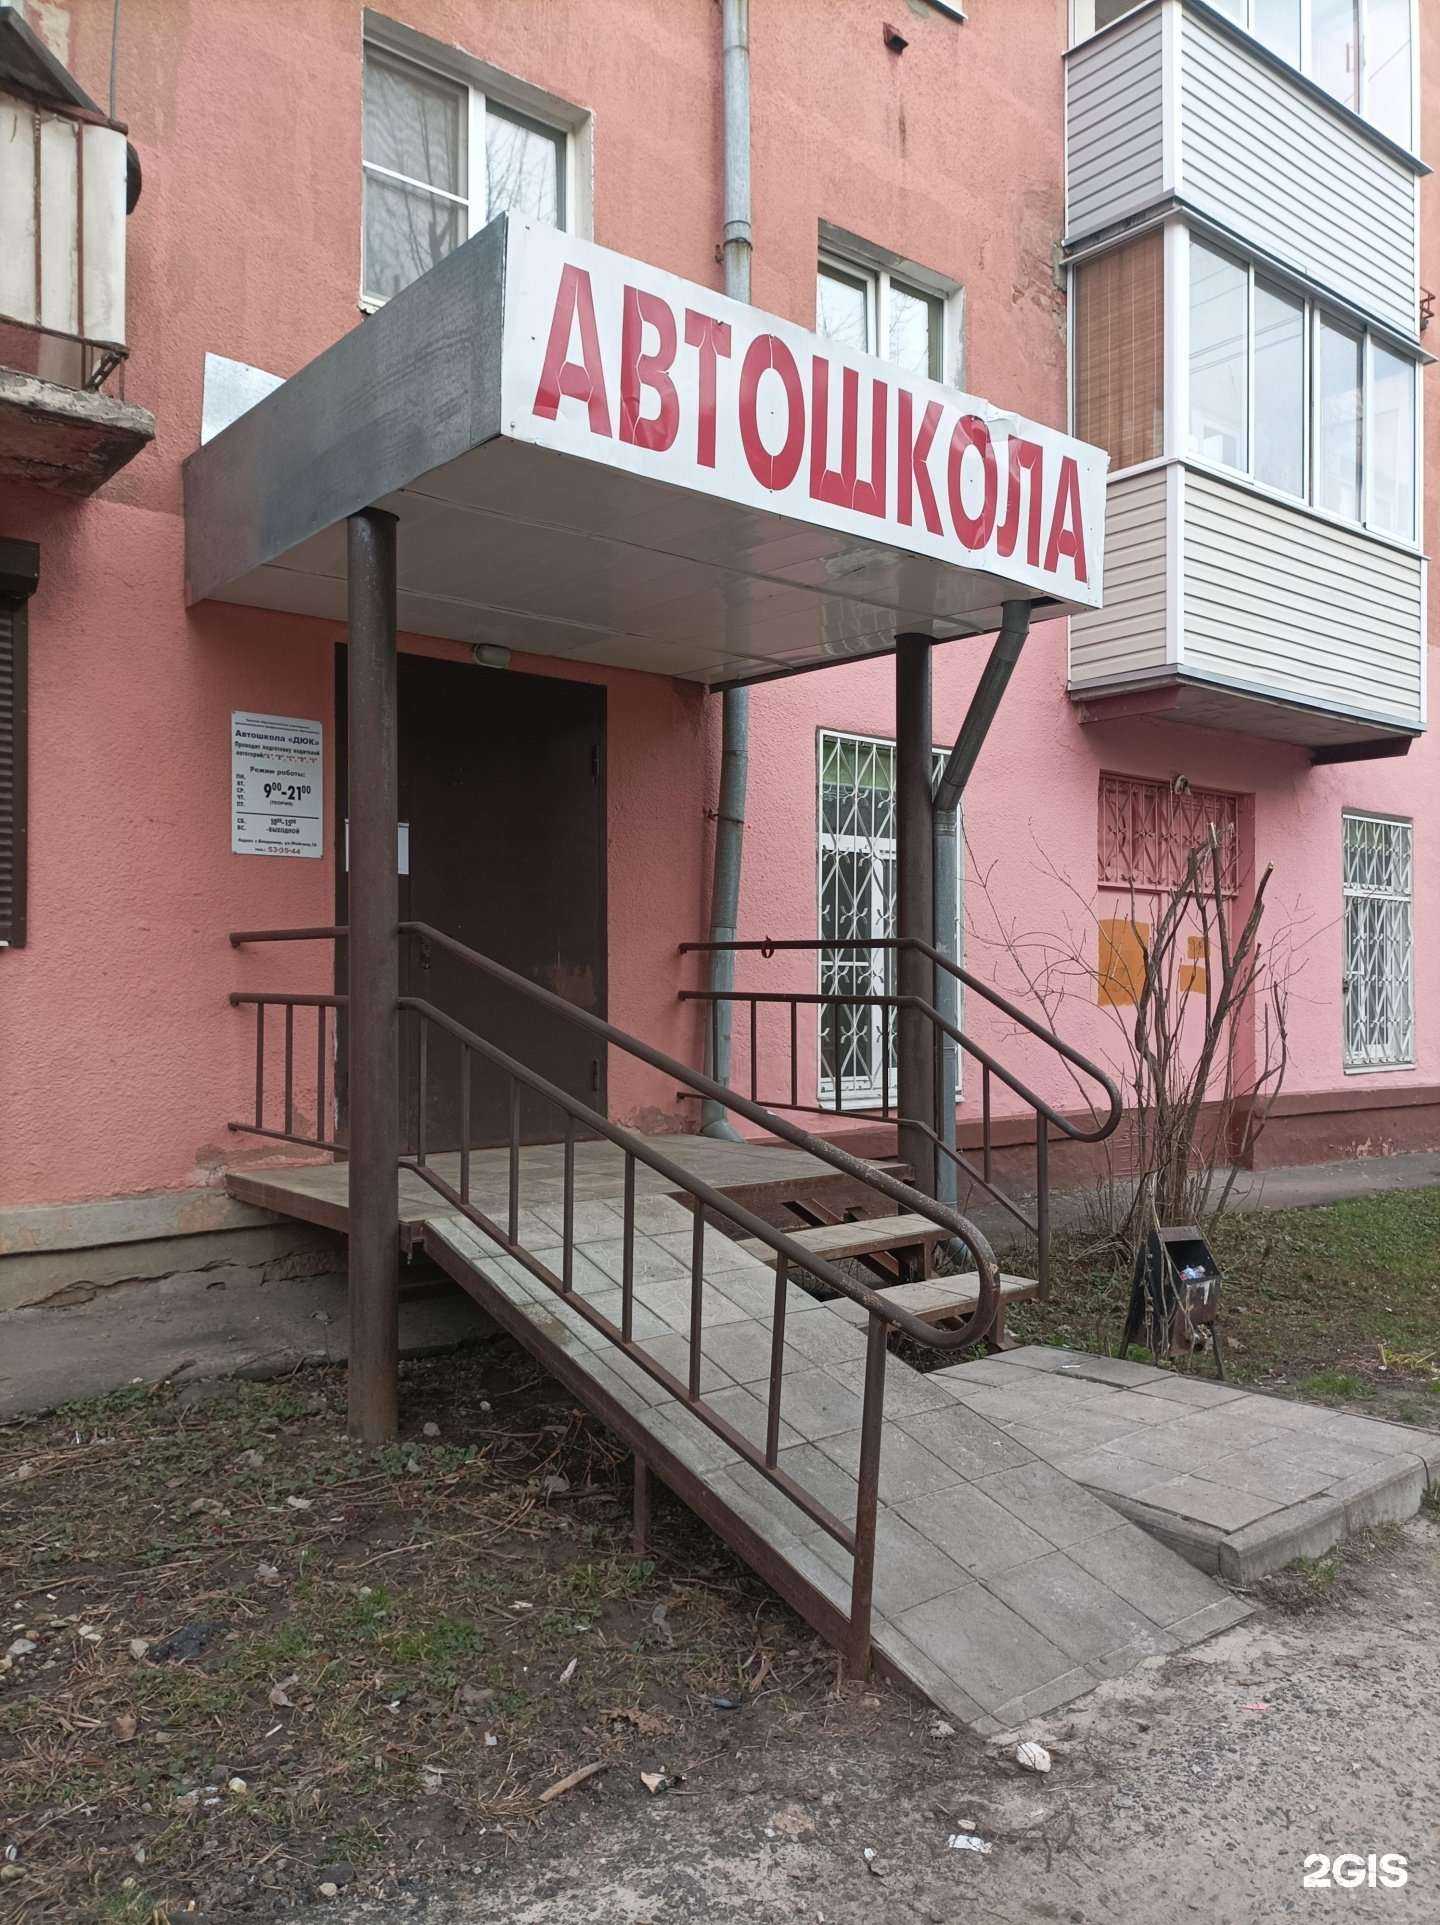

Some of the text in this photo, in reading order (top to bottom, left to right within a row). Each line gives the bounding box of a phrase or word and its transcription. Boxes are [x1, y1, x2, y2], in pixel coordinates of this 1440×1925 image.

[532, 262, 1088, 583] АВТОШКОЛА
[235, 729, 320, 746] Автошкола «ДЮК»
